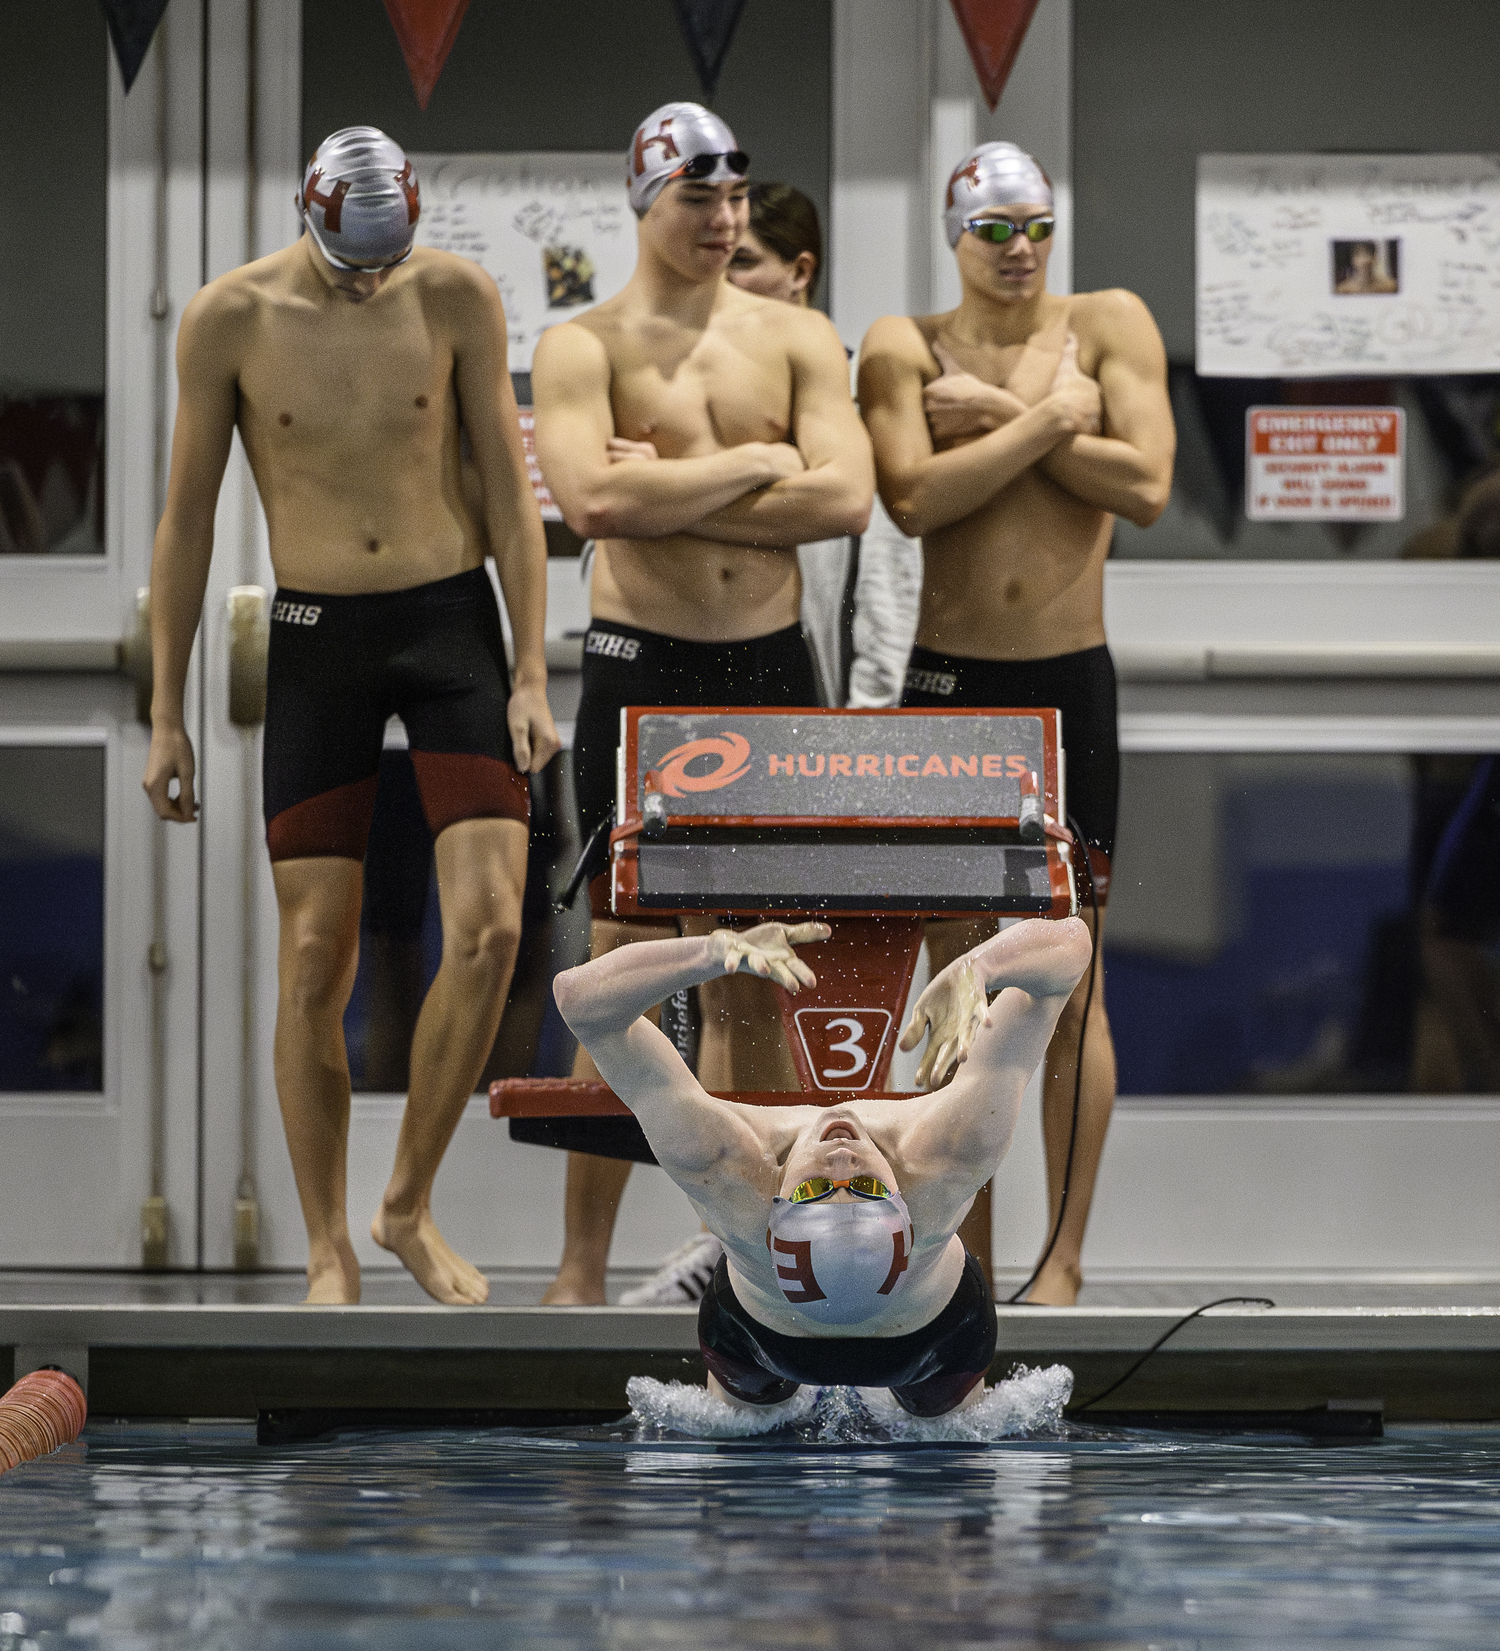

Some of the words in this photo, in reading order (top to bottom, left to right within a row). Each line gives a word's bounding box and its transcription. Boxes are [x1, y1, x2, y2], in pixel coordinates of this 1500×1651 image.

[304, 166, 353, 233] H
[1257, 416, 1392, 433] EMERGENCY
[1268, 435, 1317, 451] EXIT
[1322, 435, 1381, 451] ONLY
[768, 753, 1027, 778] HURRICANES
[822, 1017, 867, 1078] 3
